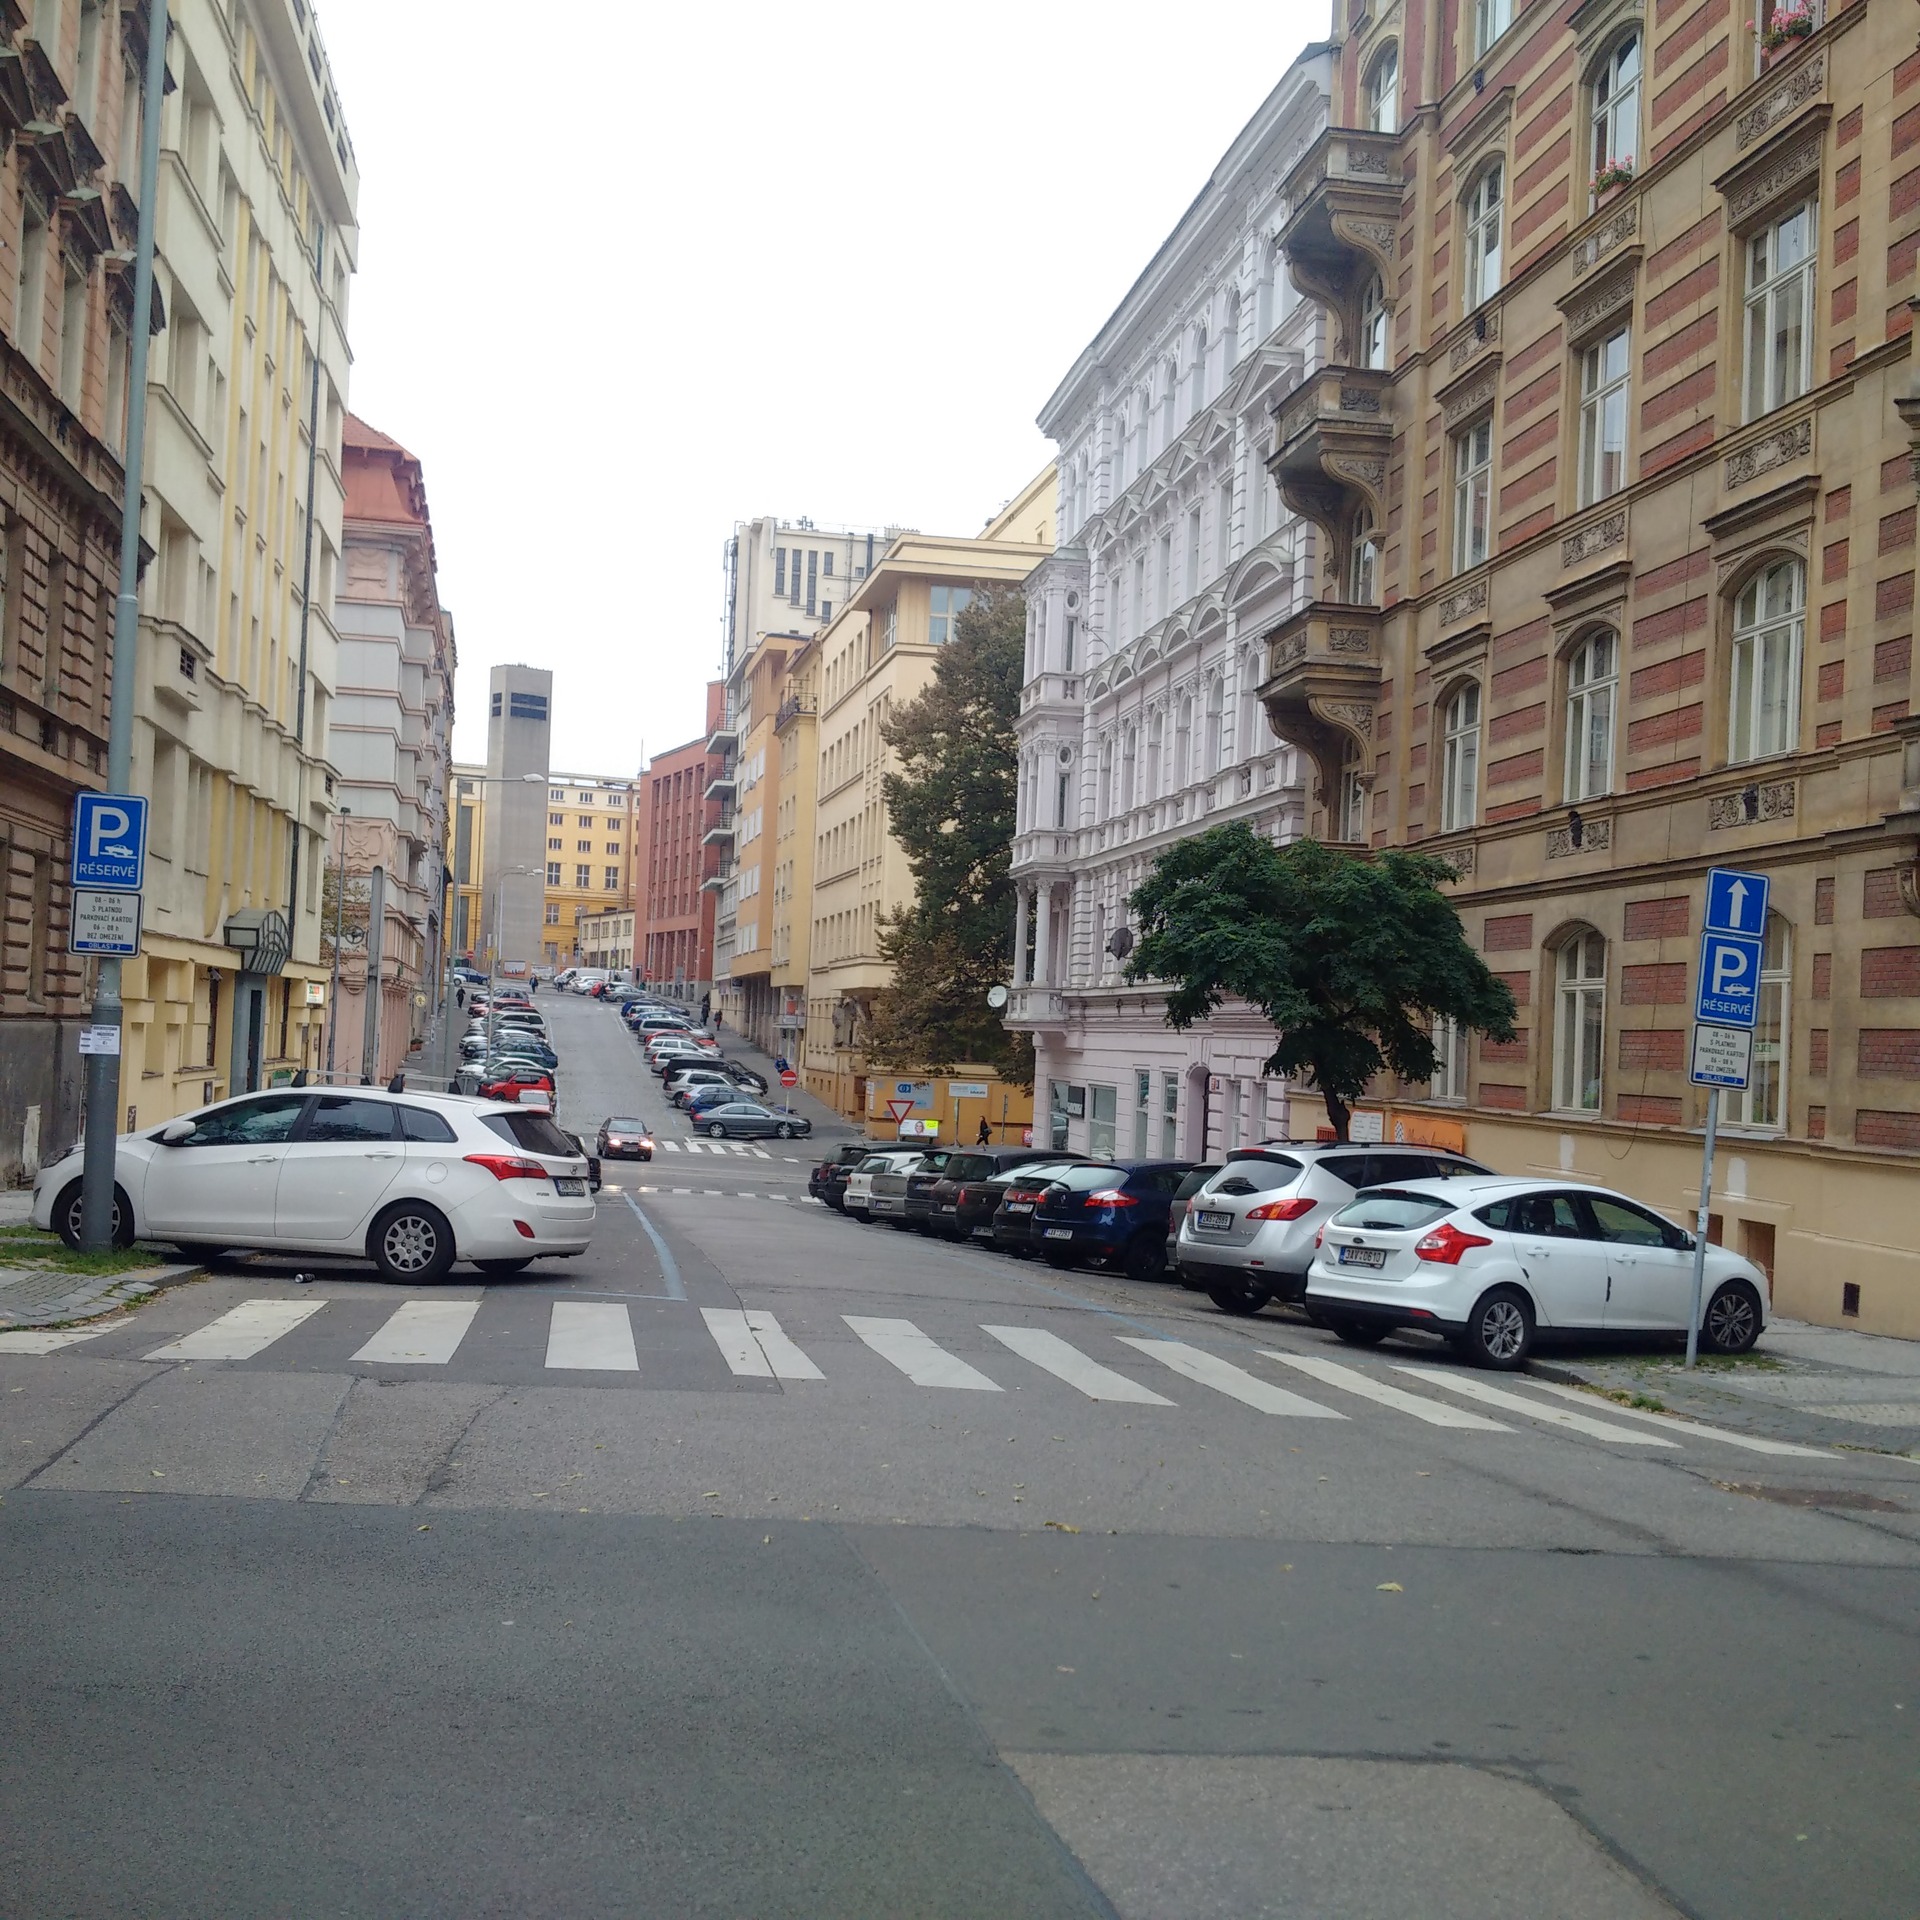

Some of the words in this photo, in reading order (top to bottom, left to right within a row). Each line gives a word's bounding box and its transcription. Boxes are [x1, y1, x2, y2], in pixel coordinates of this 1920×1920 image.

[90, 805, 130, 857] P
[79, 861, 136, 878] RÉSERVÉ
[1712, 945, 1748, 994] P
[1702, 998, 1752, 1016] RÉSERVÉ
[1700, 1046, 1725, 1055] PARKOVACÍ
[1715, 1040, 1736, 1048] PLATNOU
